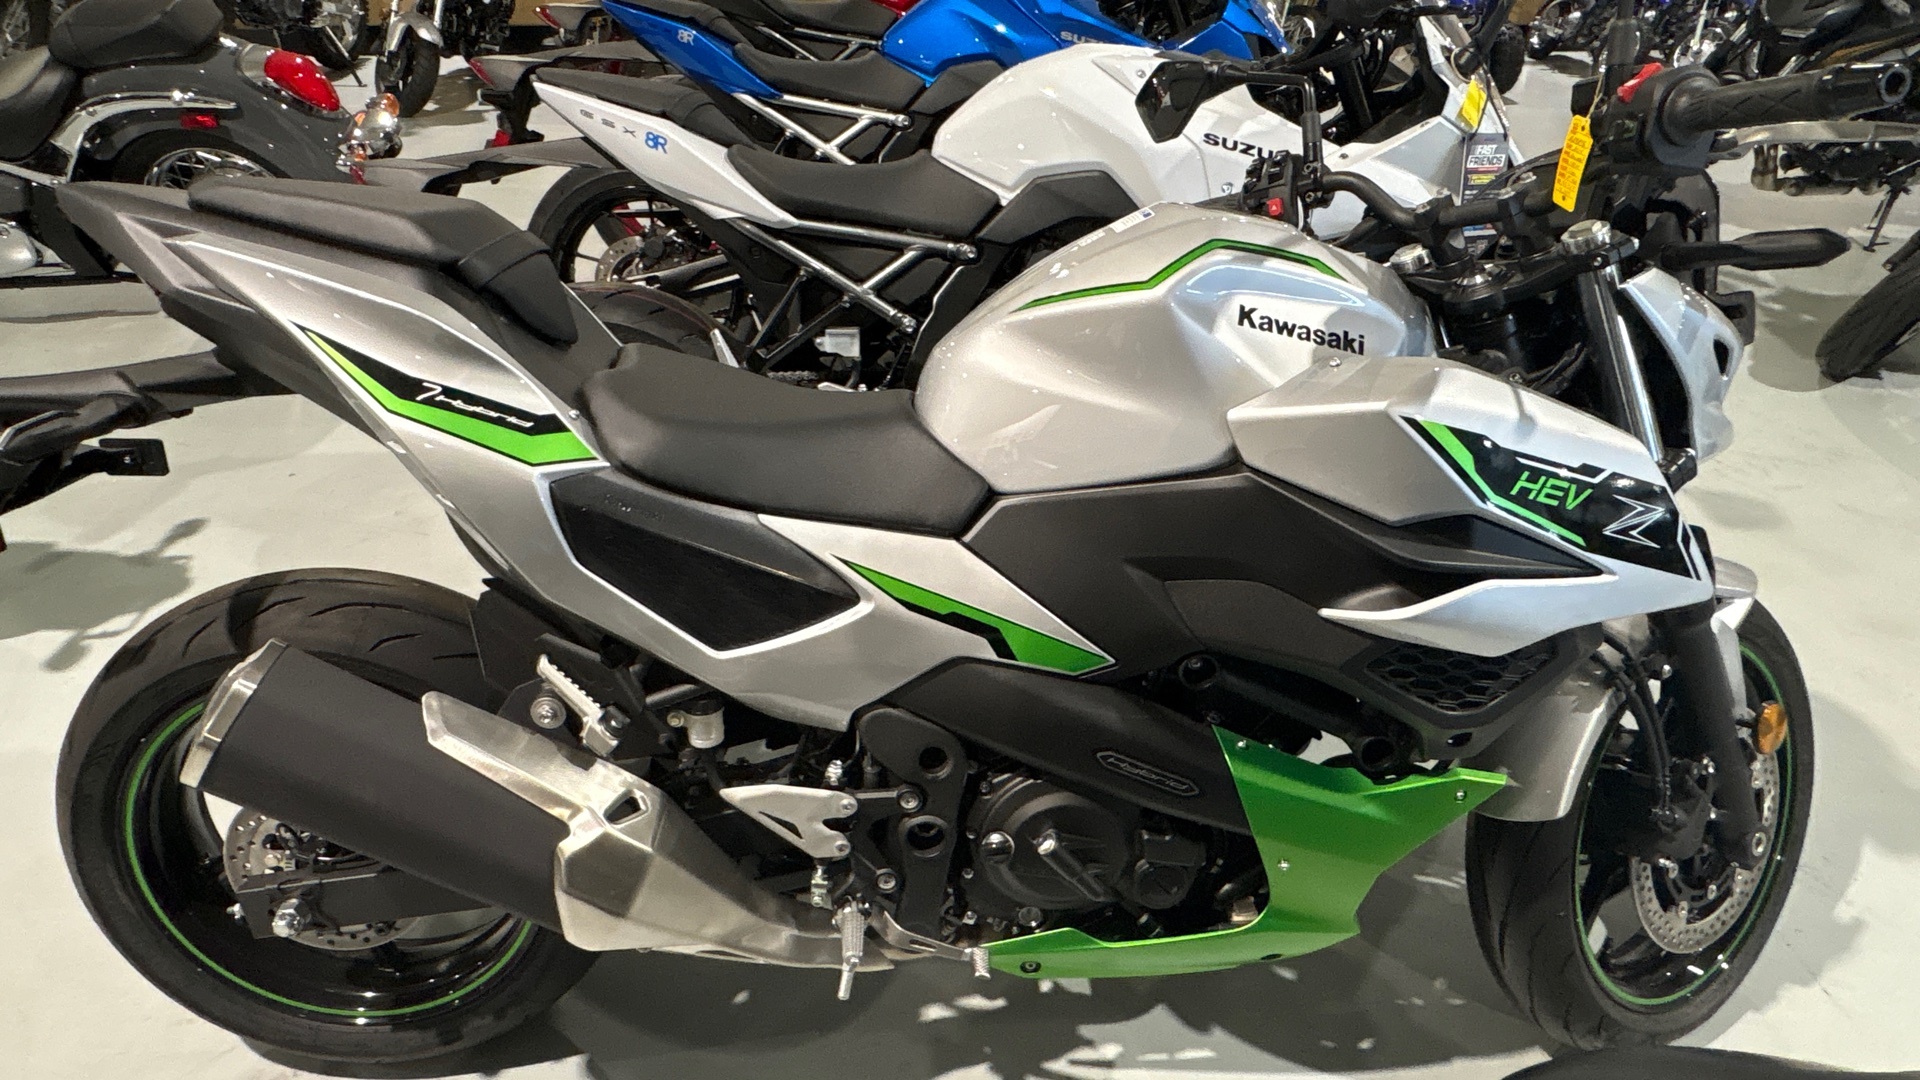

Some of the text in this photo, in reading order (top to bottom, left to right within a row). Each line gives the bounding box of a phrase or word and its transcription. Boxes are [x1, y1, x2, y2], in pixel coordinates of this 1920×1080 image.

[678, 29, 694, 46] 8R
[645, 131, 668, 154] 8R
[1203, 133, 1274, 159] SUZU
[1476, 144, 1498, 155] FAST
[1468, 155, 1504, 166] FRIENDS
[1237, 303, 1365, 356] Kawasaki
[1509, 470, 1594, 511] HEV
[1106, 757, 1190, 790] Hybrid
